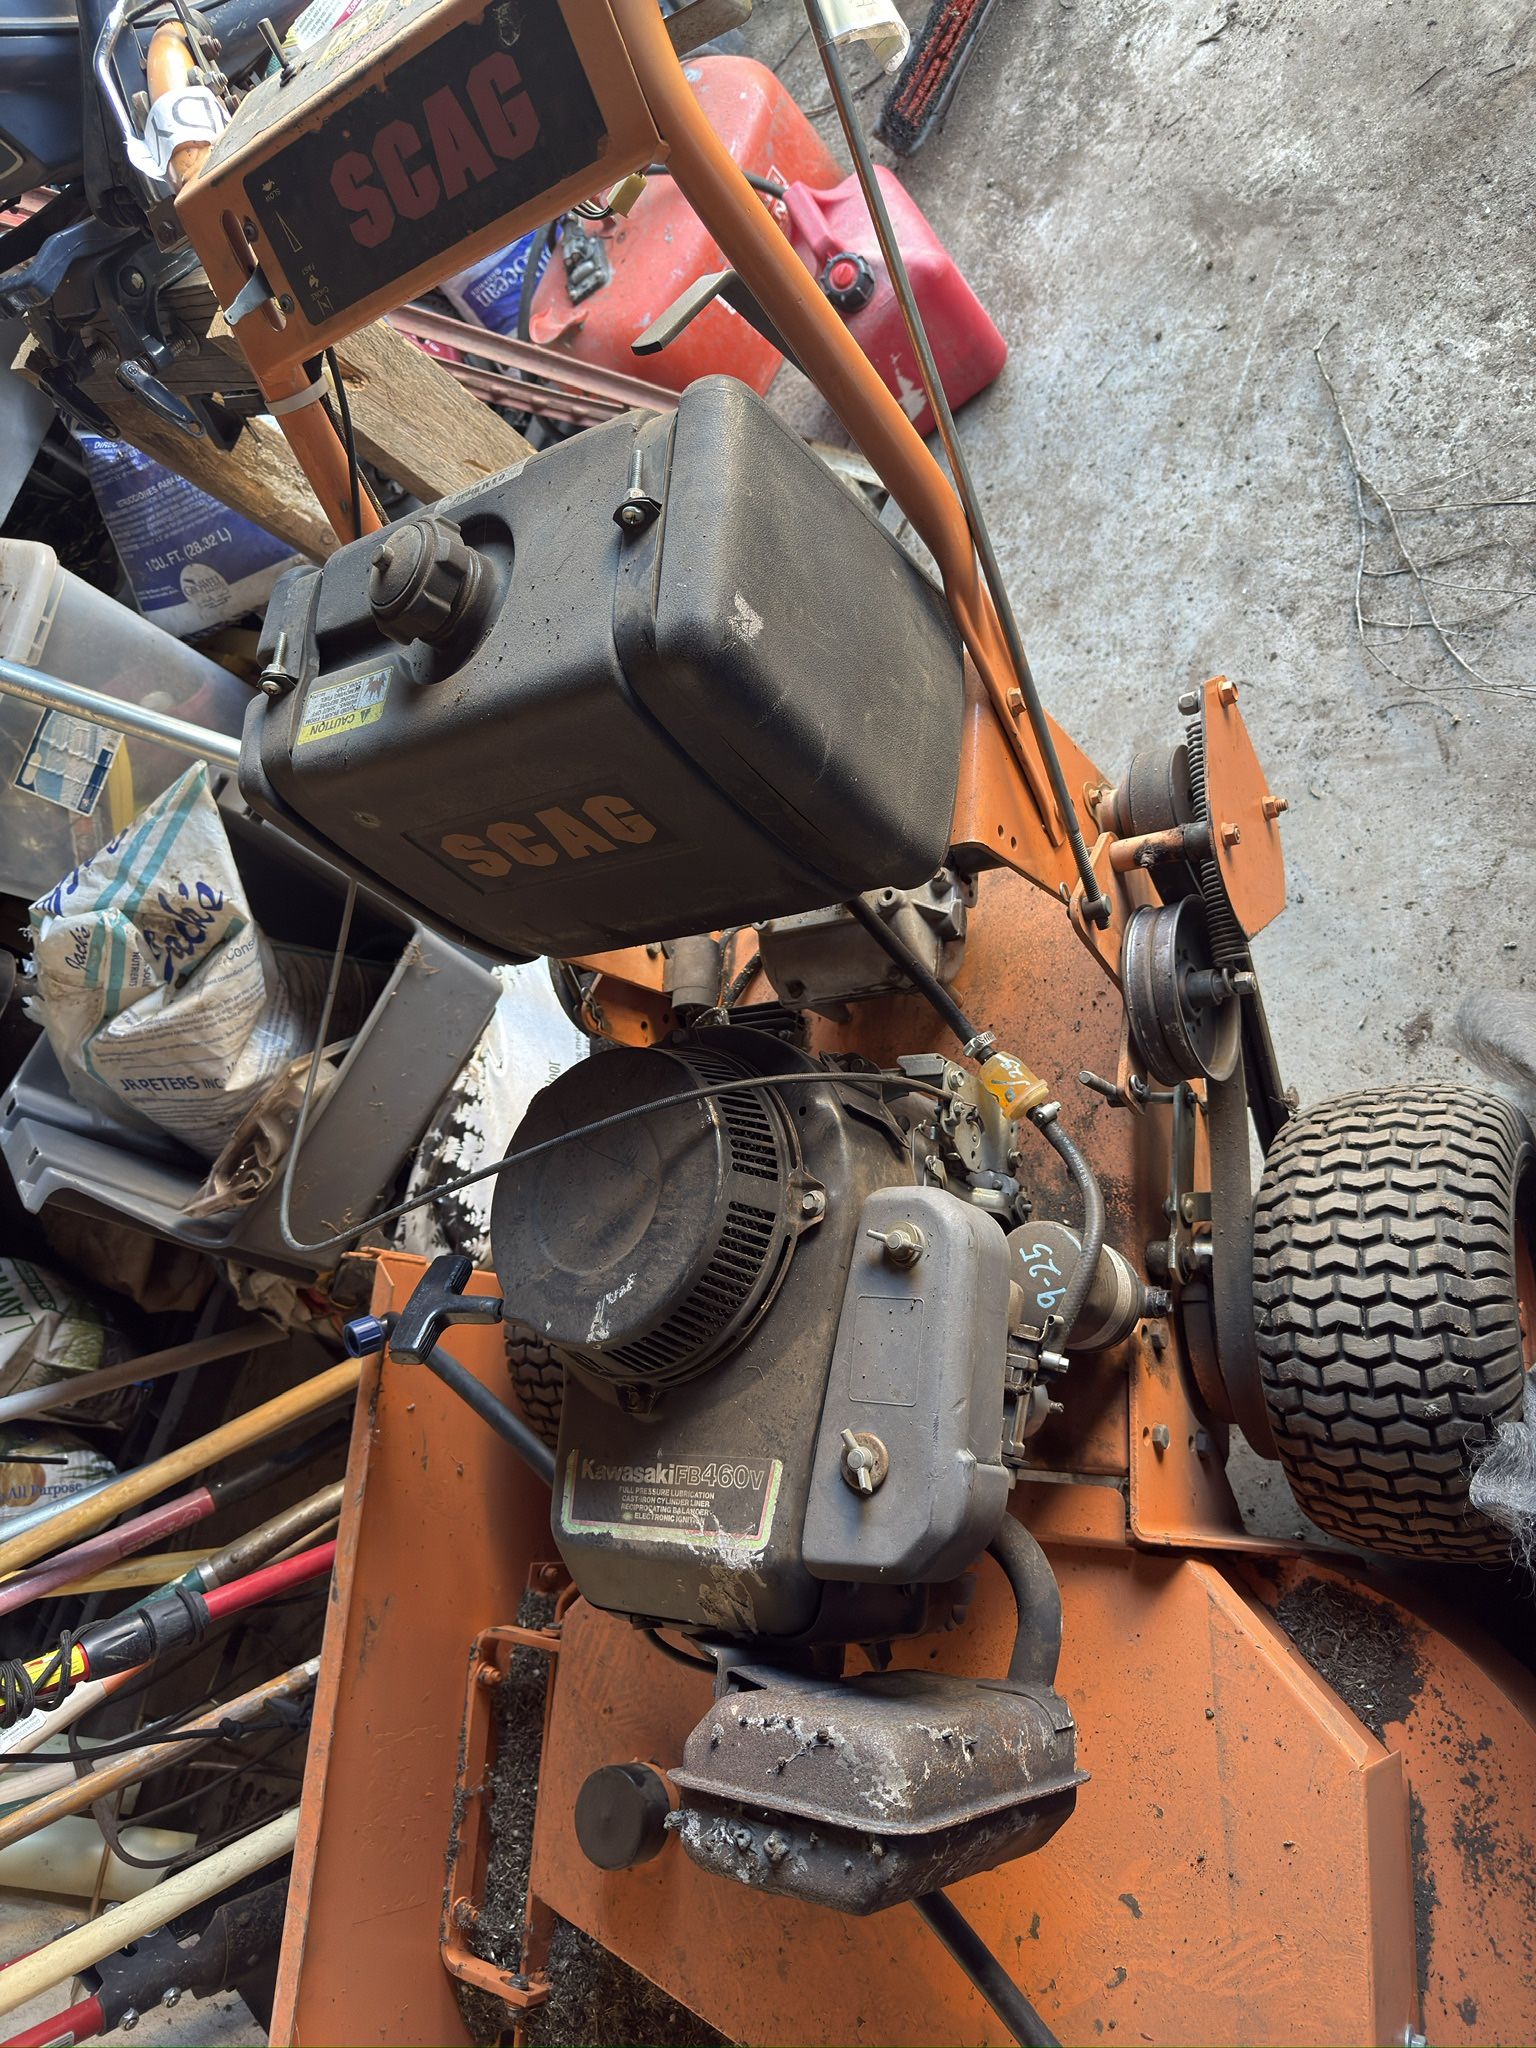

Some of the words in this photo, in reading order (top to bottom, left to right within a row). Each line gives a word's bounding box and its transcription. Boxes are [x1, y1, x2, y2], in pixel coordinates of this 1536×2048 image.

[330, 52, 541, 248] SCAG
[168, 549, 185, 565] FT.
[184, 534, 217, 560] (28.32
[219, 527, 233, 544] L)
[310, 713, 354, 735] CAUTION
[441, 795, 656, 877] SCAG
[65, 926, 91, 972] Jack's
[581, 1458, 674, 1484] Kawasaki
[674, 1463, 765, 1490] FB460V
[9, 1486, 26, 1499] All
[31, 1482, 82, 1498] Purpose
[622, 1495, 656, 1504] CAST-IRON
[657, 1498, 689, 1506] CYLINDER
[636, 1488, 670, 1496] PRESSURE
[670, 1489, 714, 1499] LUBRICATION
[621, 1503, 671, 1513] RECIPROCATING
[672, 1507, 709, 1516] BALANCER
[635, 1512, 675, 1522] ELECTRONIC
